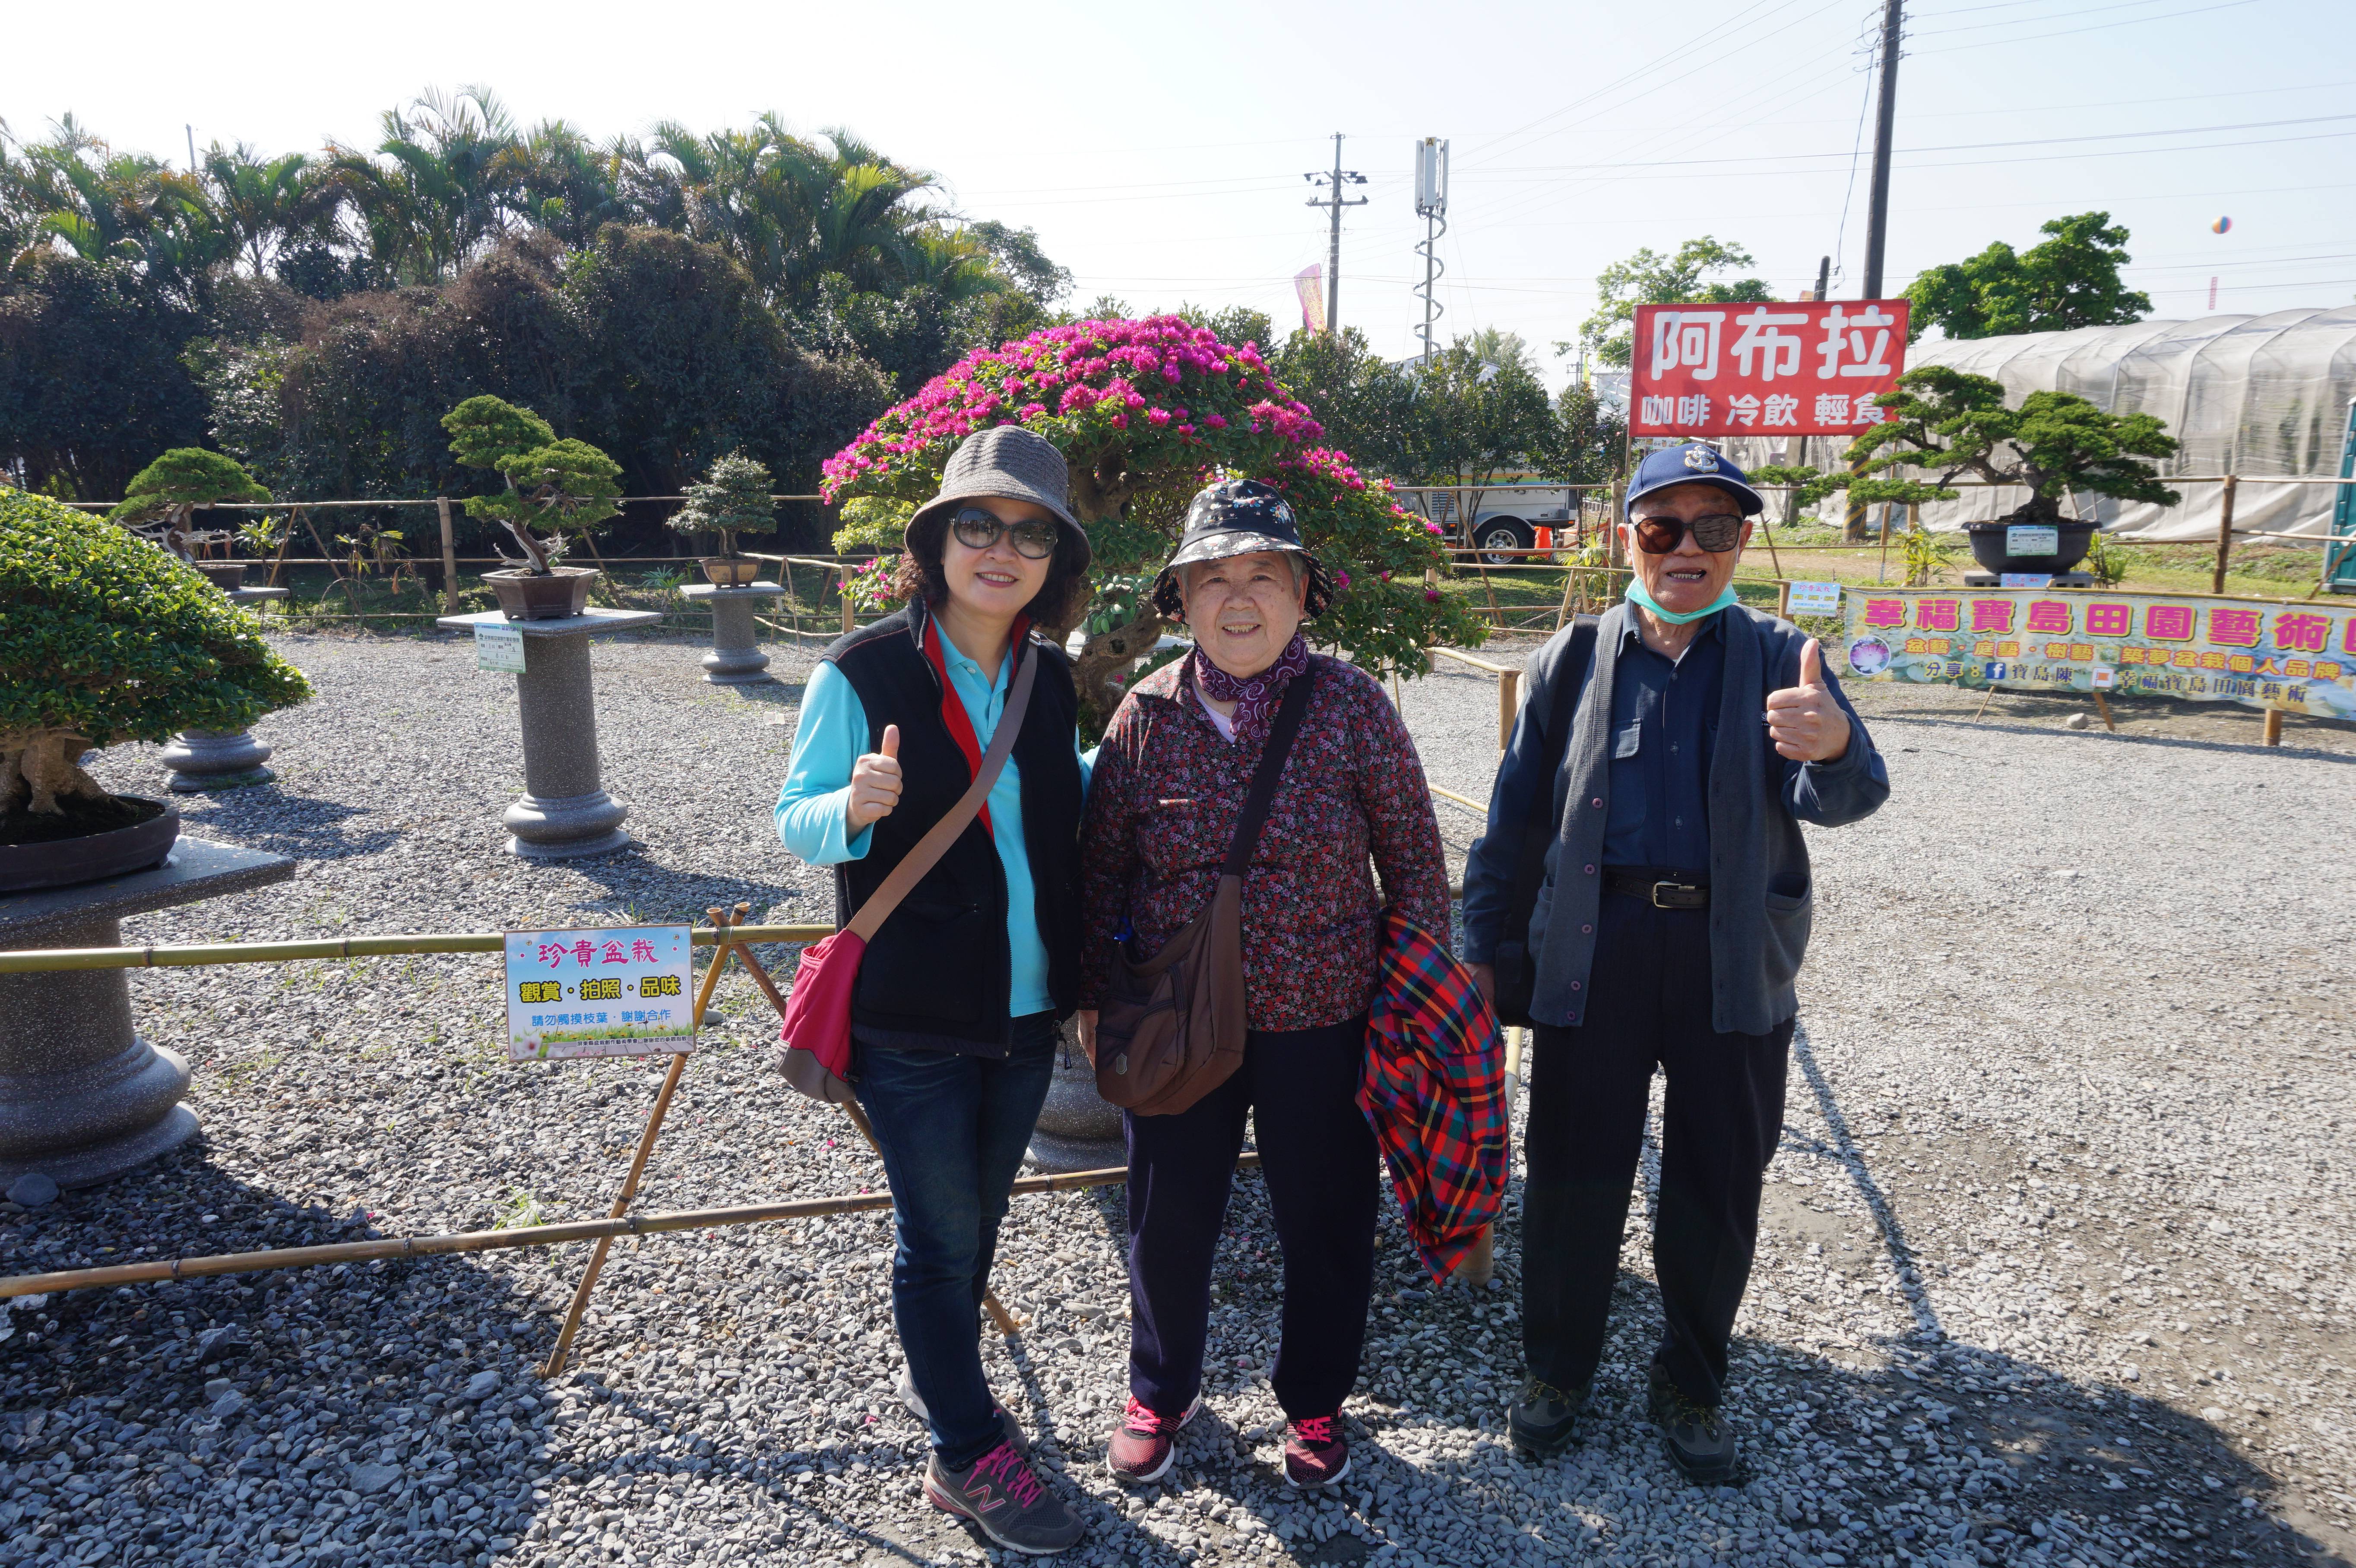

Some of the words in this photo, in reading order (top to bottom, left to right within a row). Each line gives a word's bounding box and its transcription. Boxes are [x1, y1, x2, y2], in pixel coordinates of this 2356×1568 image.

[1427, 138, 1434, 146] A
[1651, 305, 1894, 382] 阿布拉
[1641, 394, 1710, 427] 咖啡
[1726, 393, 1799, 427] 冷飲
[1814, 392, 1885, 427] 輕食
[1864, 598, 2356, 654] 幸福寶島田園藝術
[2120, 647, 2341, 681] 築夢盆栽個人品牌
[2012, 664, 2074, 683] 寶島陳
[2118, 670, 2306, 704] 幸福寶島田園藝術
[538, 938, 659, 969] 珍貴盆栽
[966, 1484, 1006, 1513] N
